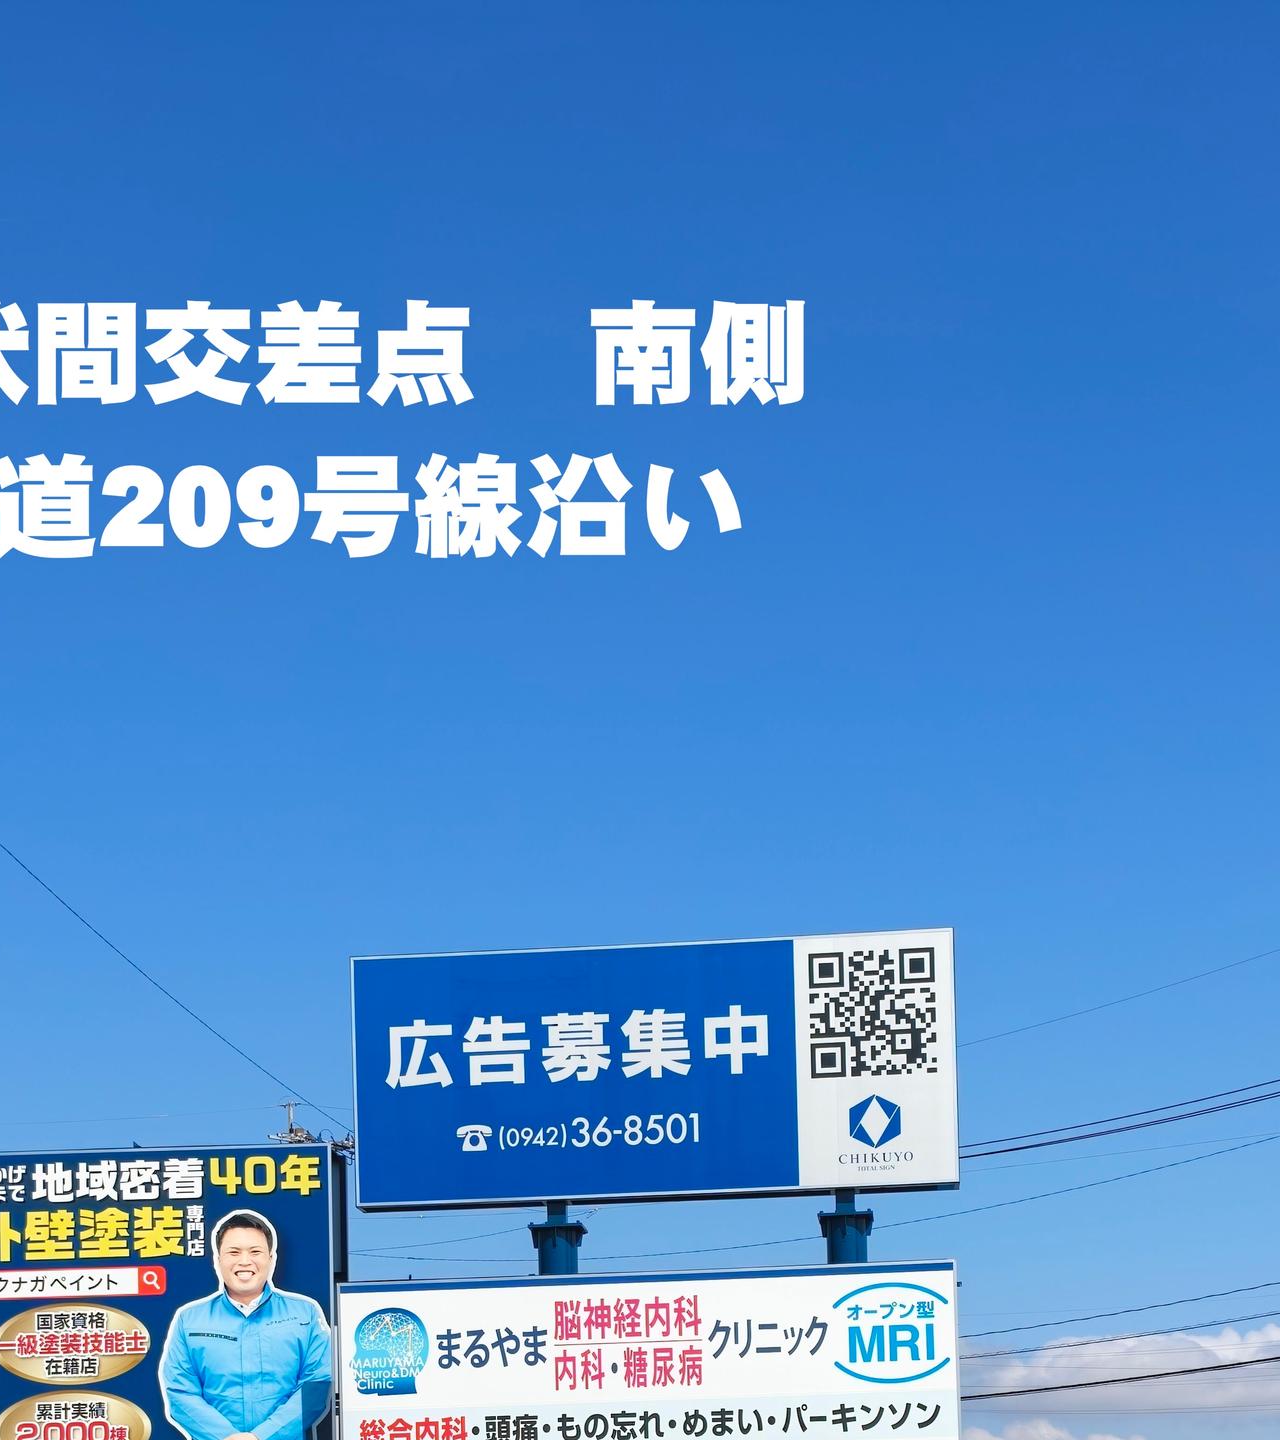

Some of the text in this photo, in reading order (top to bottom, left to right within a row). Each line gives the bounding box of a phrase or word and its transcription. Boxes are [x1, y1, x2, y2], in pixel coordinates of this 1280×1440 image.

[384, 1004, 770, 1091] 広告募集中
[838, 1150, 914, 1166] CHIKUYO
[32, 1154, 321, 1203] 地域密着40年
[186, 1205, 205, 1257] 専門店
[36, 1312, 106, 1331] 国家資格
[553, 1295, 703, 1341] 脳神経内科
[846, 1300, 935, 1322] オープン型
[436, 1316, 829, 1370] まるやま クリニック
[848, 1323, 936, 1363] MRI
[45, 1357, 98, 1376] 在籍店
[350, 1357, 424, 1370] MARUYAMA
[352, 1367, 422, 1380] Neuro&DM
[554, 1345, 703, 1391] 内科・糖尿病
[357, 1378, 394, 1390] Clinic
[36, 1402, 106, 1421] 累計実績
